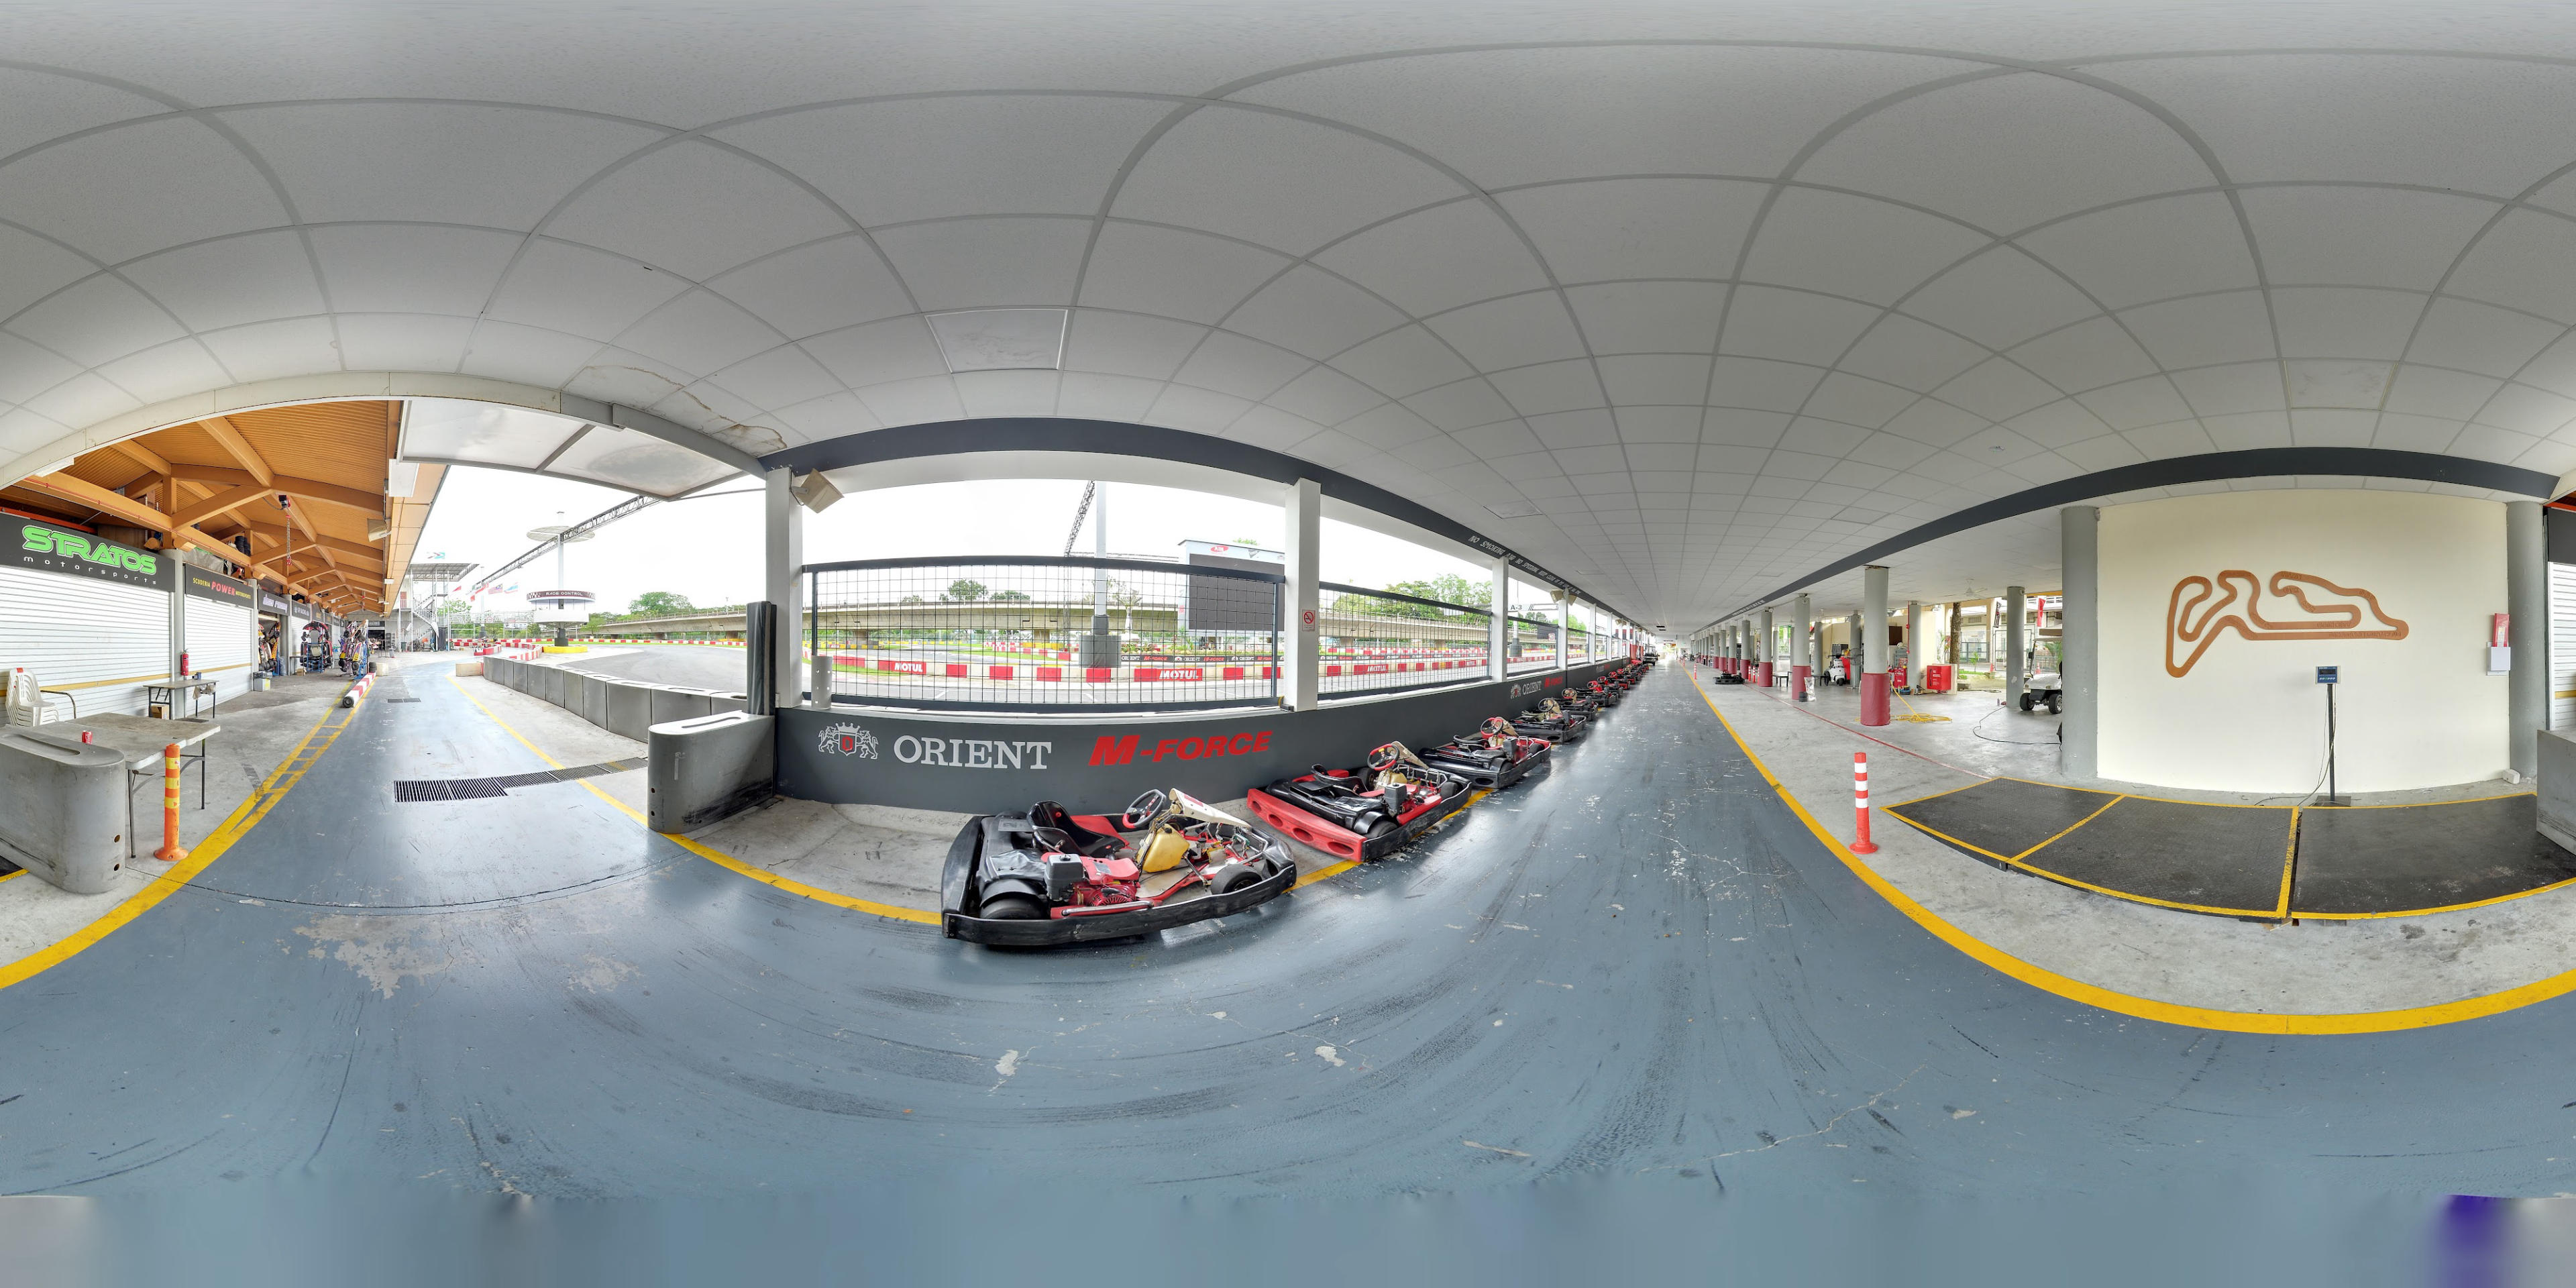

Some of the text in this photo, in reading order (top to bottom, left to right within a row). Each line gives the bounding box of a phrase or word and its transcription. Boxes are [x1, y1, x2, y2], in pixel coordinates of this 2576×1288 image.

[22, 525, 156, 575] STRATOS
[1480, 541, 1505, 555] SMOKING
[23, 556, 156, 584] motorsports
[193, 578, 210, 588] SCUDERIA
[211, 582, 235, 596] POWER
[894, 662, 922, 672] MOTUL
[1159, 669, 1199, 680] MOTUL
[1522, 681, 1542, 695] ORIENT
[894, 731, 1273, 769] ORIENT M-FORCE
